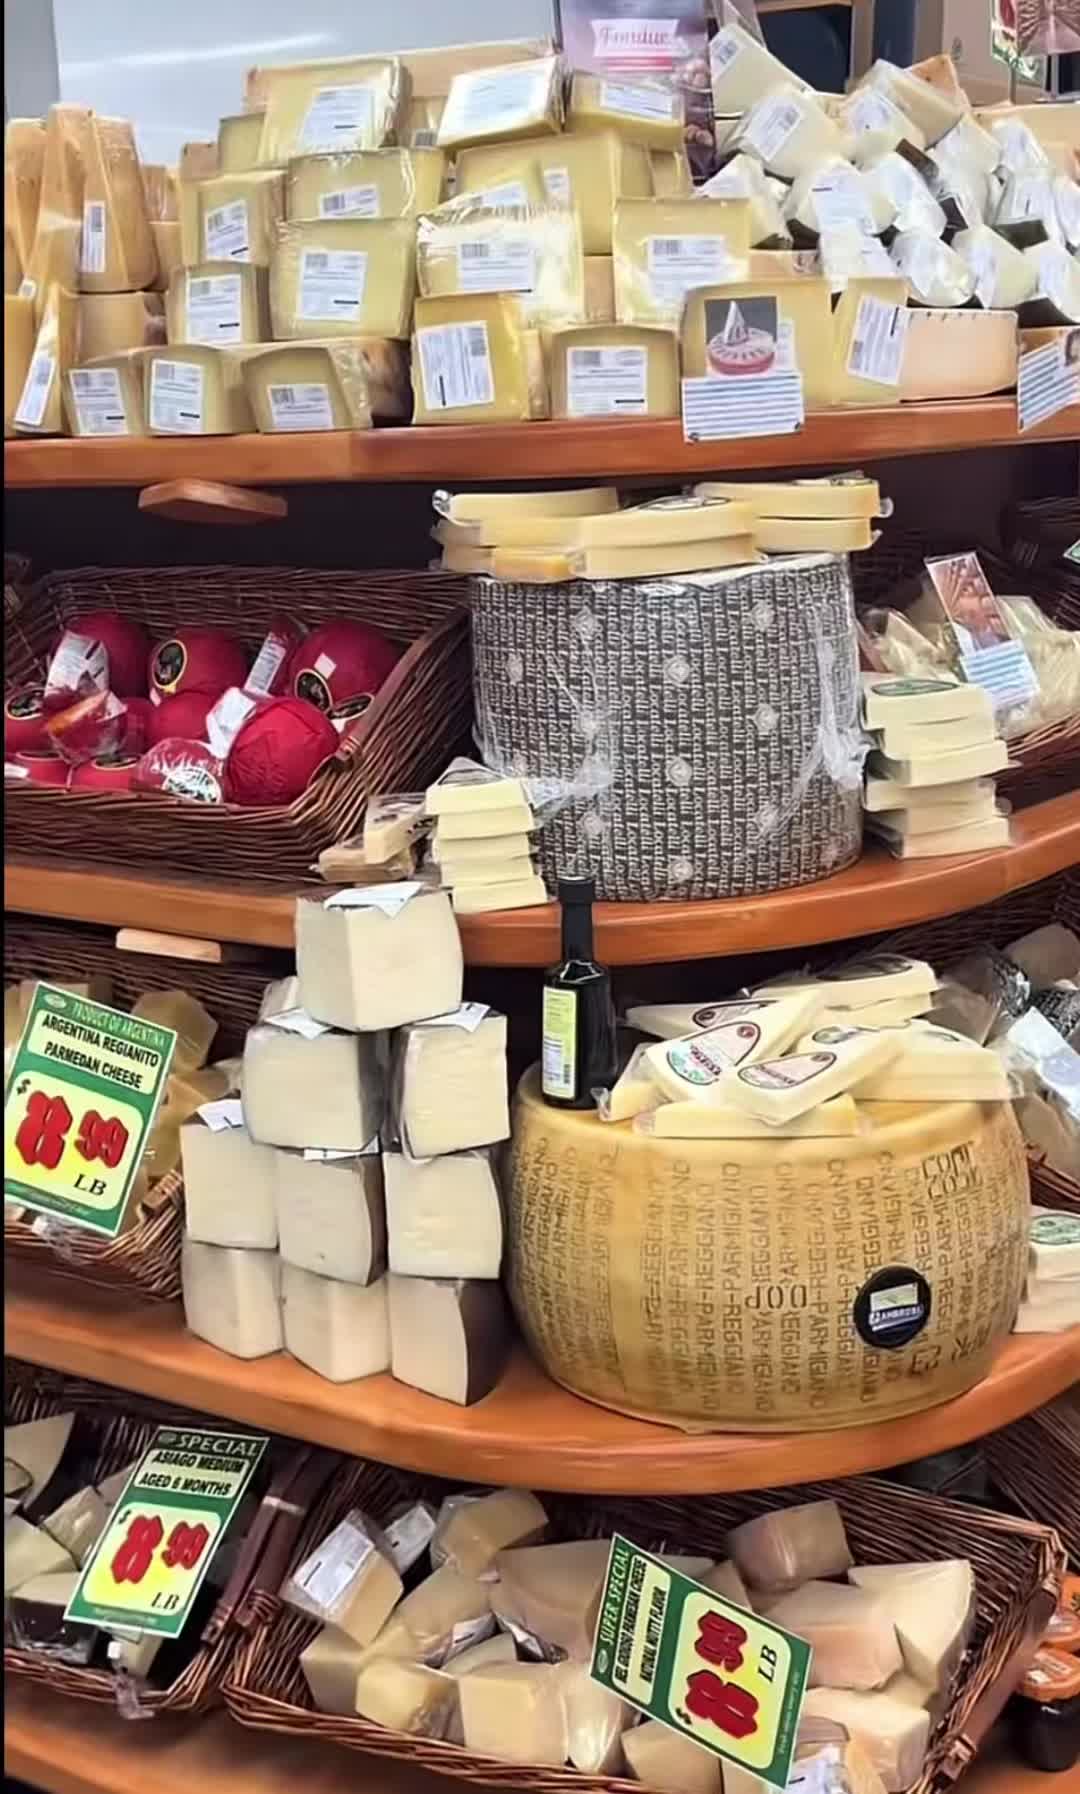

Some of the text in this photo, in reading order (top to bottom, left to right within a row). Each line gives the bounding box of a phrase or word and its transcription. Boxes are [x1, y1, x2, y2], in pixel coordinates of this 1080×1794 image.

[42, 1014, 159, 1067] ARGENTINA REGIANITO
[102, 1062, 143, 1088] CHEESE
[73, 1174, 107, 1196] LB
[879, 1151, 906, 1262] ARMIGIANO
[745, 1283, 807, 1309] DOP
[176, 1434, 259, 1456] SPECIAL
[151, 1452, 198, 1467] ASIAGO
[139, 1472, 172, 1488] AGED
[181, 1478, 233, 1496] MONTHS
[151, 1592, 180, 1610] LB
[600, 1547, 629, 1646] SUPER SPECIAL
[757, 1645, 778, 1684] LB
